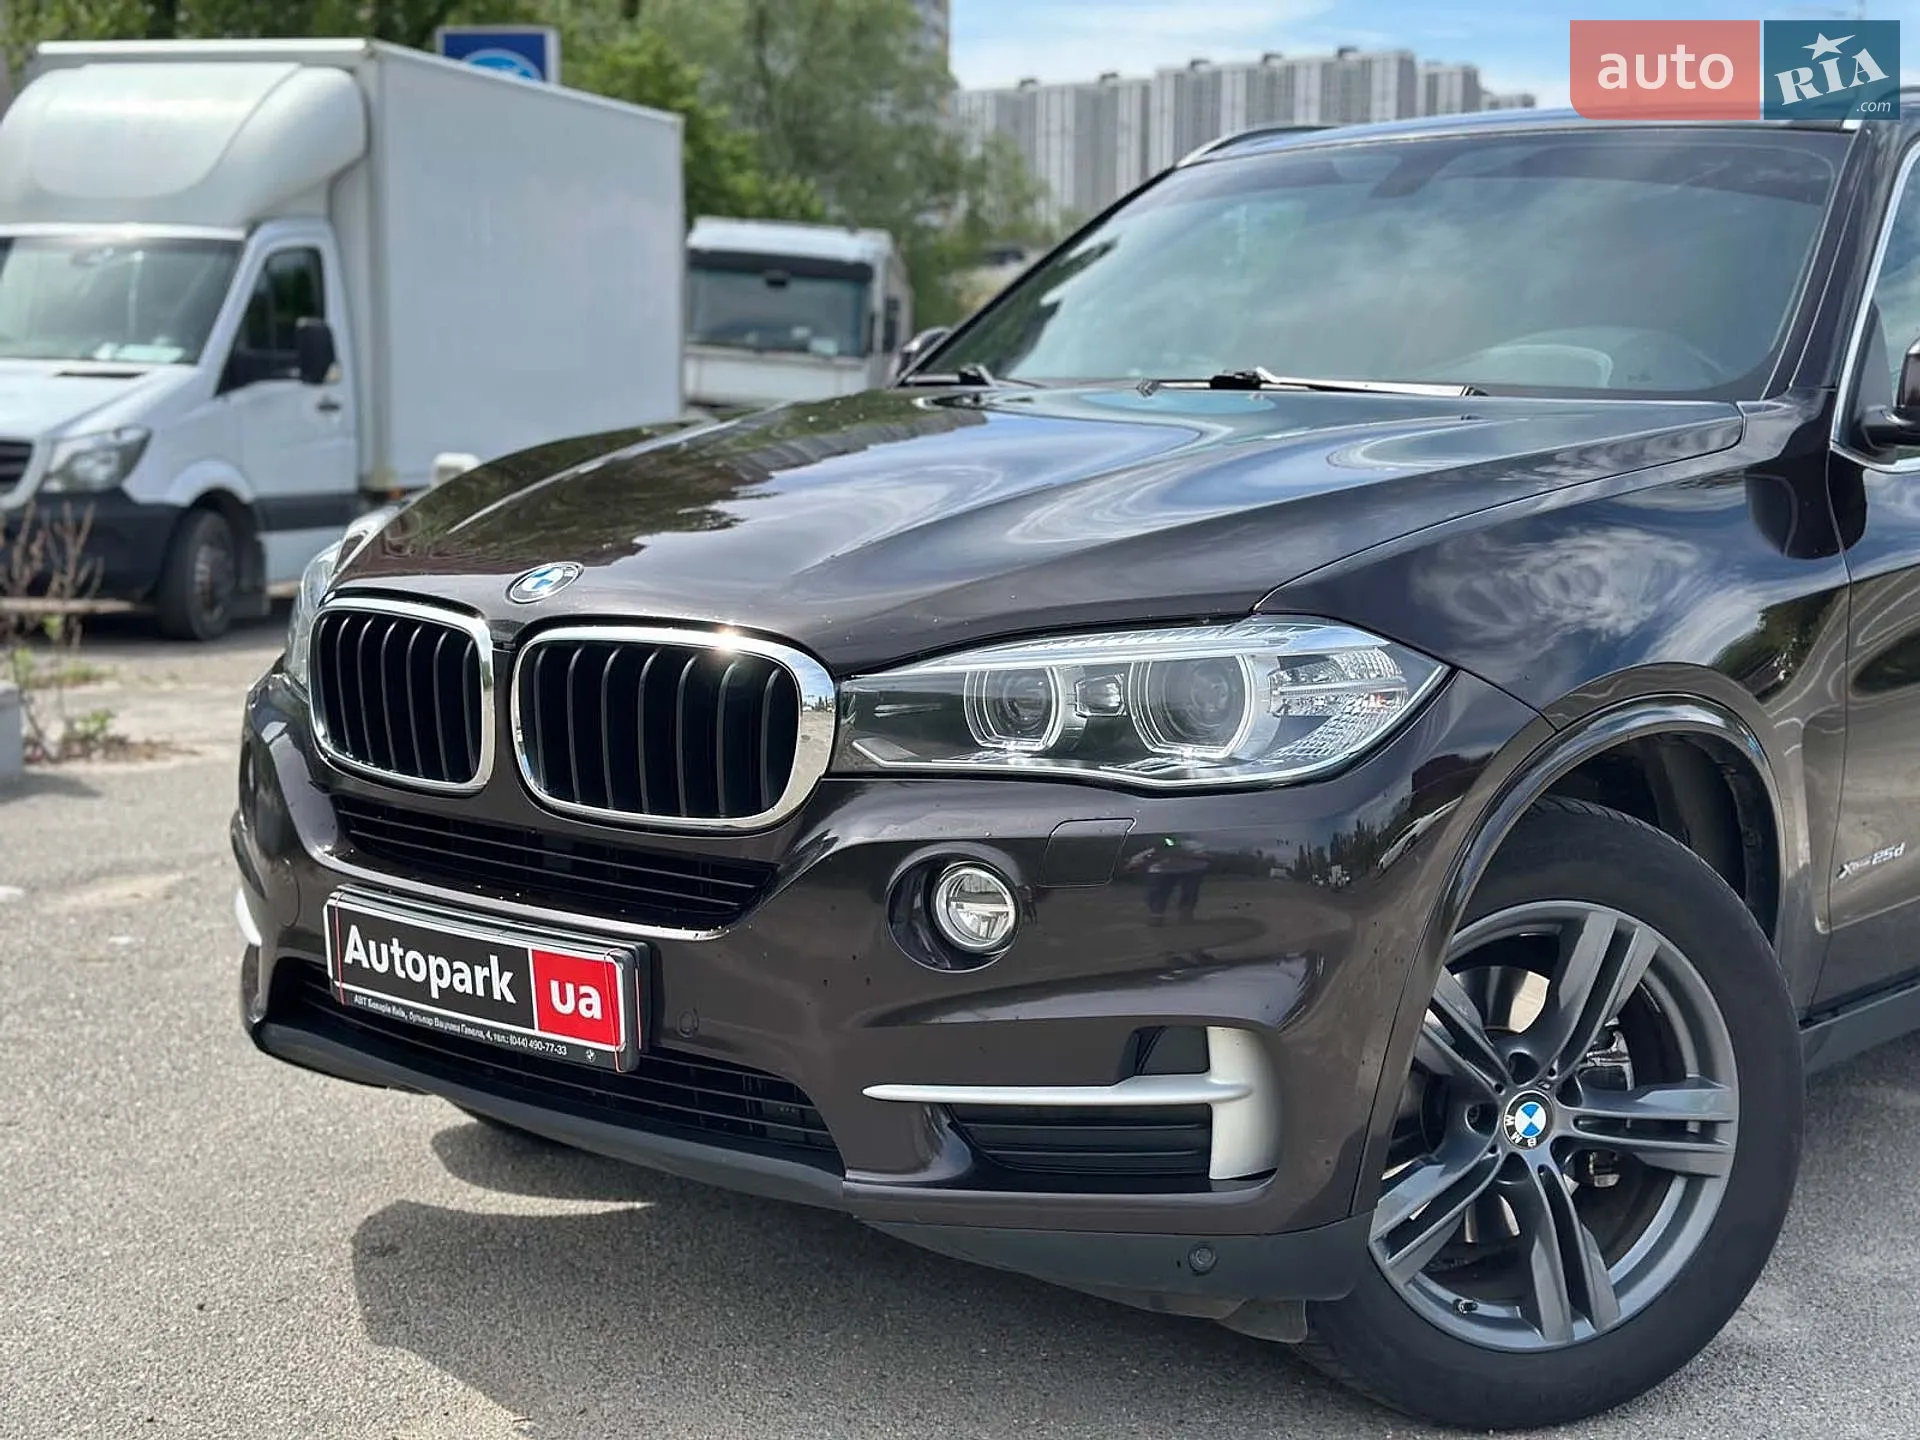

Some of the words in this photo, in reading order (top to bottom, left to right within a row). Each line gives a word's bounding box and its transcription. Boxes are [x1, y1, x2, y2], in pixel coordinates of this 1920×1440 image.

[344, 924, 517, 1005] Autopark
[549, 977, 603, 1021] ua
[528, 1039, 568, 1056] 490-77-33
